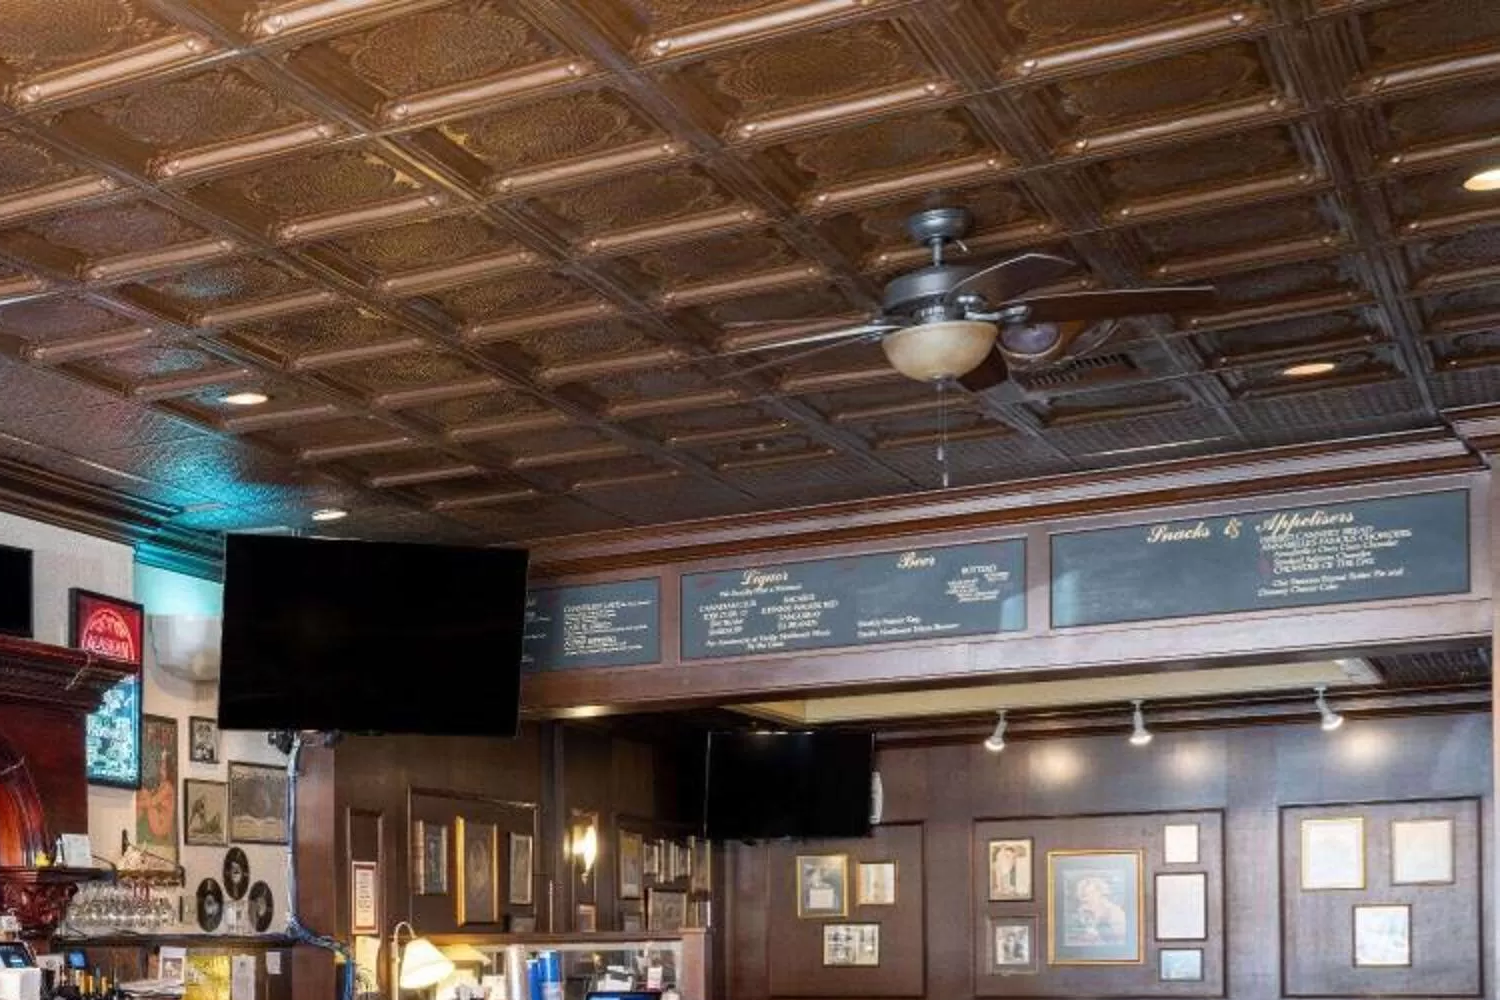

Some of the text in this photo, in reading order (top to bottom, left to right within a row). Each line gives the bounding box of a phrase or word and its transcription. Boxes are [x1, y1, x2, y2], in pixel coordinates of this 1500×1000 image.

[1147, 522, 1210, 543] Snacks
[1224, 518, 1242, 538] &
[897, 551, 937, 570] Beer
[740, 570, 789, 588] Liquor
